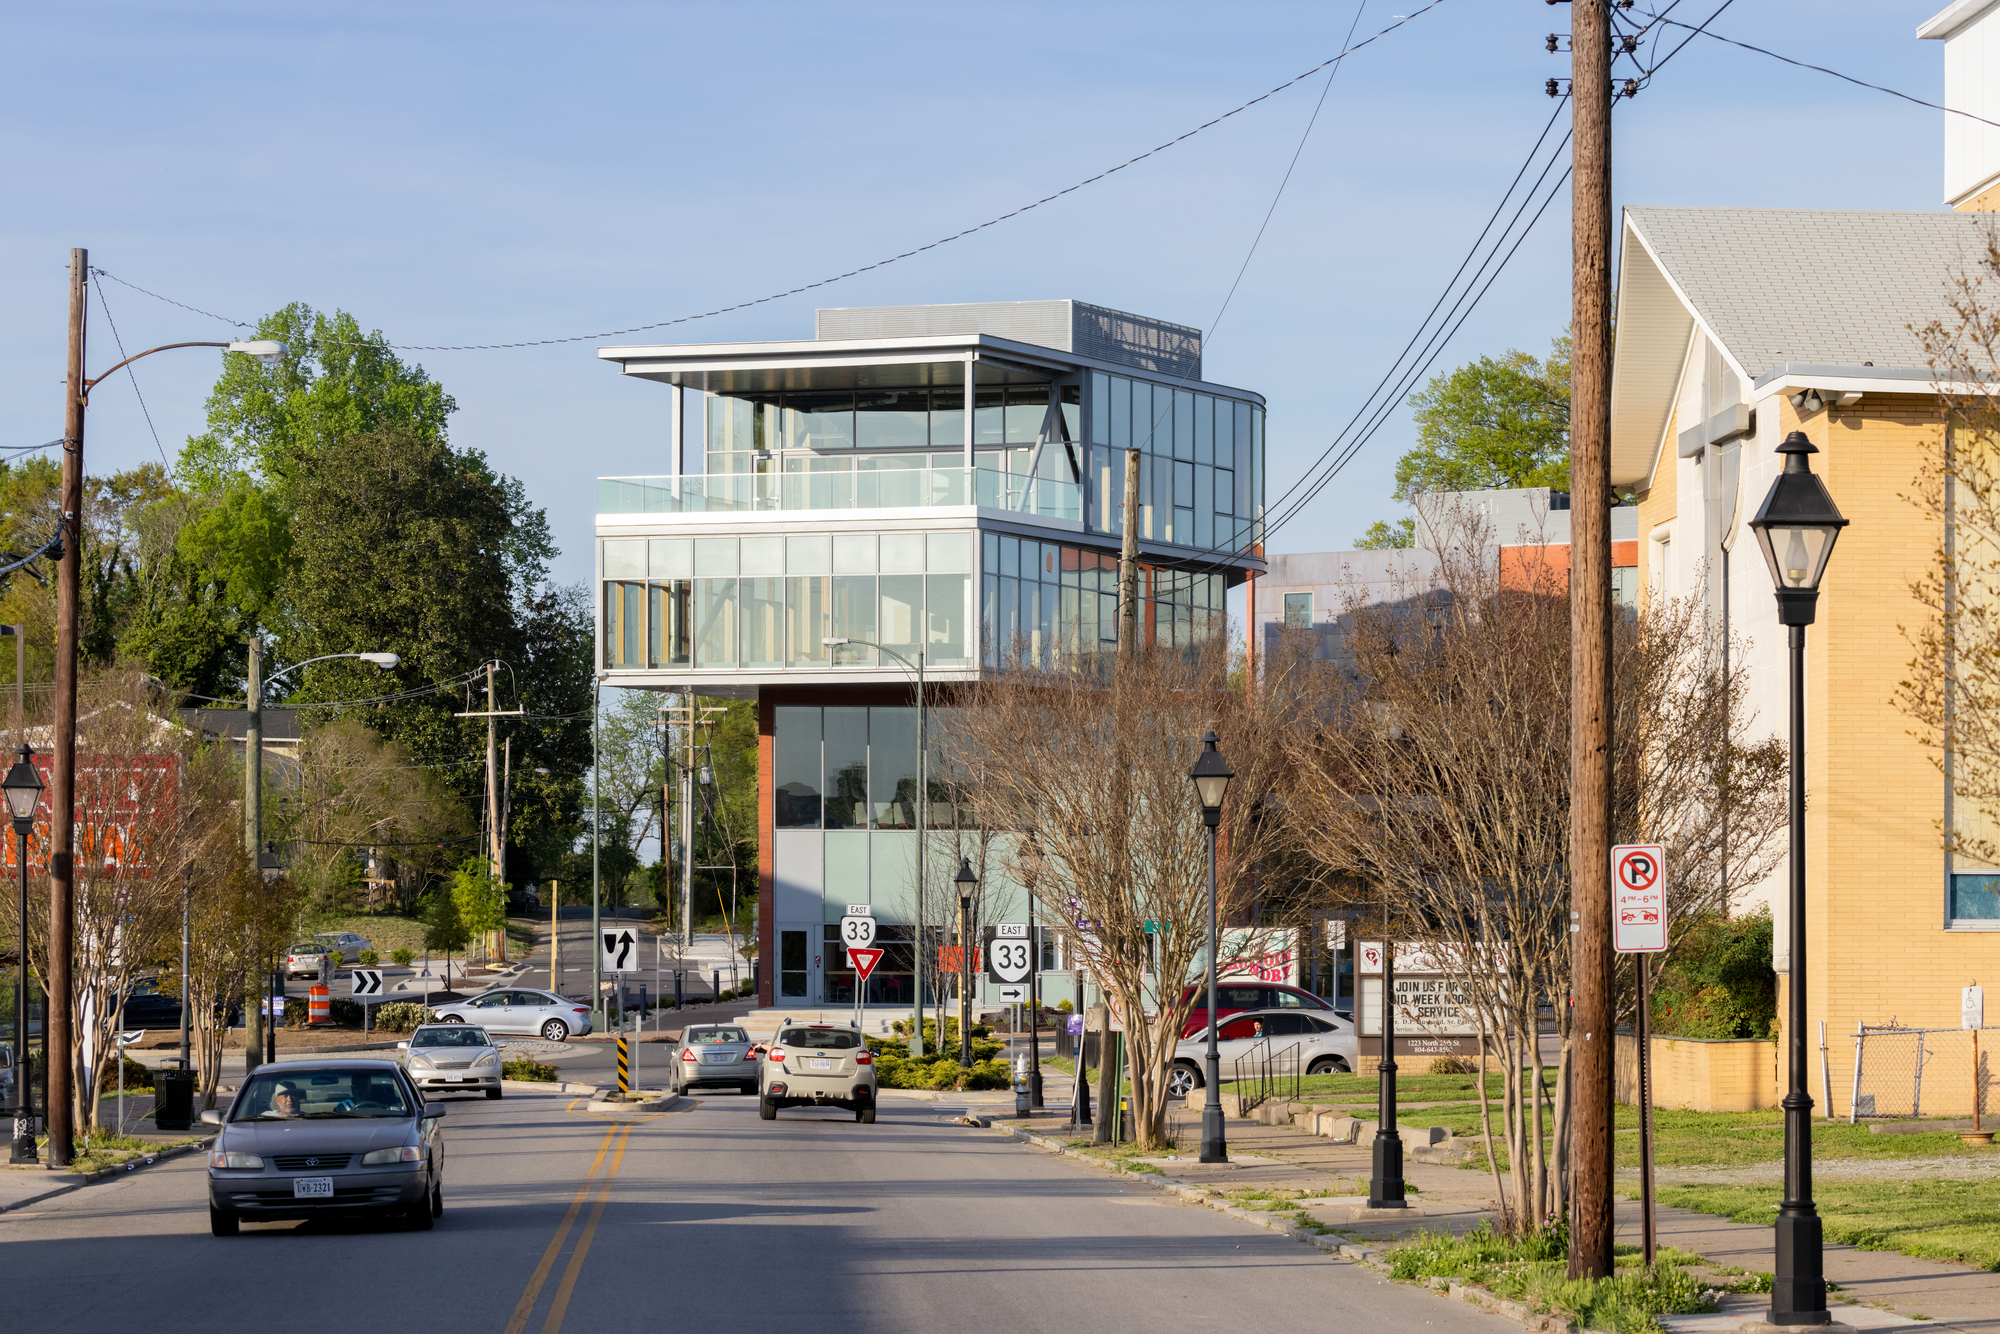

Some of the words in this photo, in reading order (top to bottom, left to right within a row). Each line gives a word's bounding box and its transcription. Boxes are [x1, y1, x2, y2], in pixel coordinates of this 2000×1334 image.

[1631, 858, 1650, 884] P
[850, 905, 867, 914] EAST
[847, 921, 870, 941] 33
[1001, 925, 1021, 935] EAST
[998, 944, 1027, 970] 33
[1395, 981, 1420, 992] JOIN
[1423, 981, 1436, 992] US
[1413, 994, 1441, 1005] WEEK
[1418, 1006, 1460, 1018] SERVICE
[297, 1183, 331, 1193] UWB-2321
